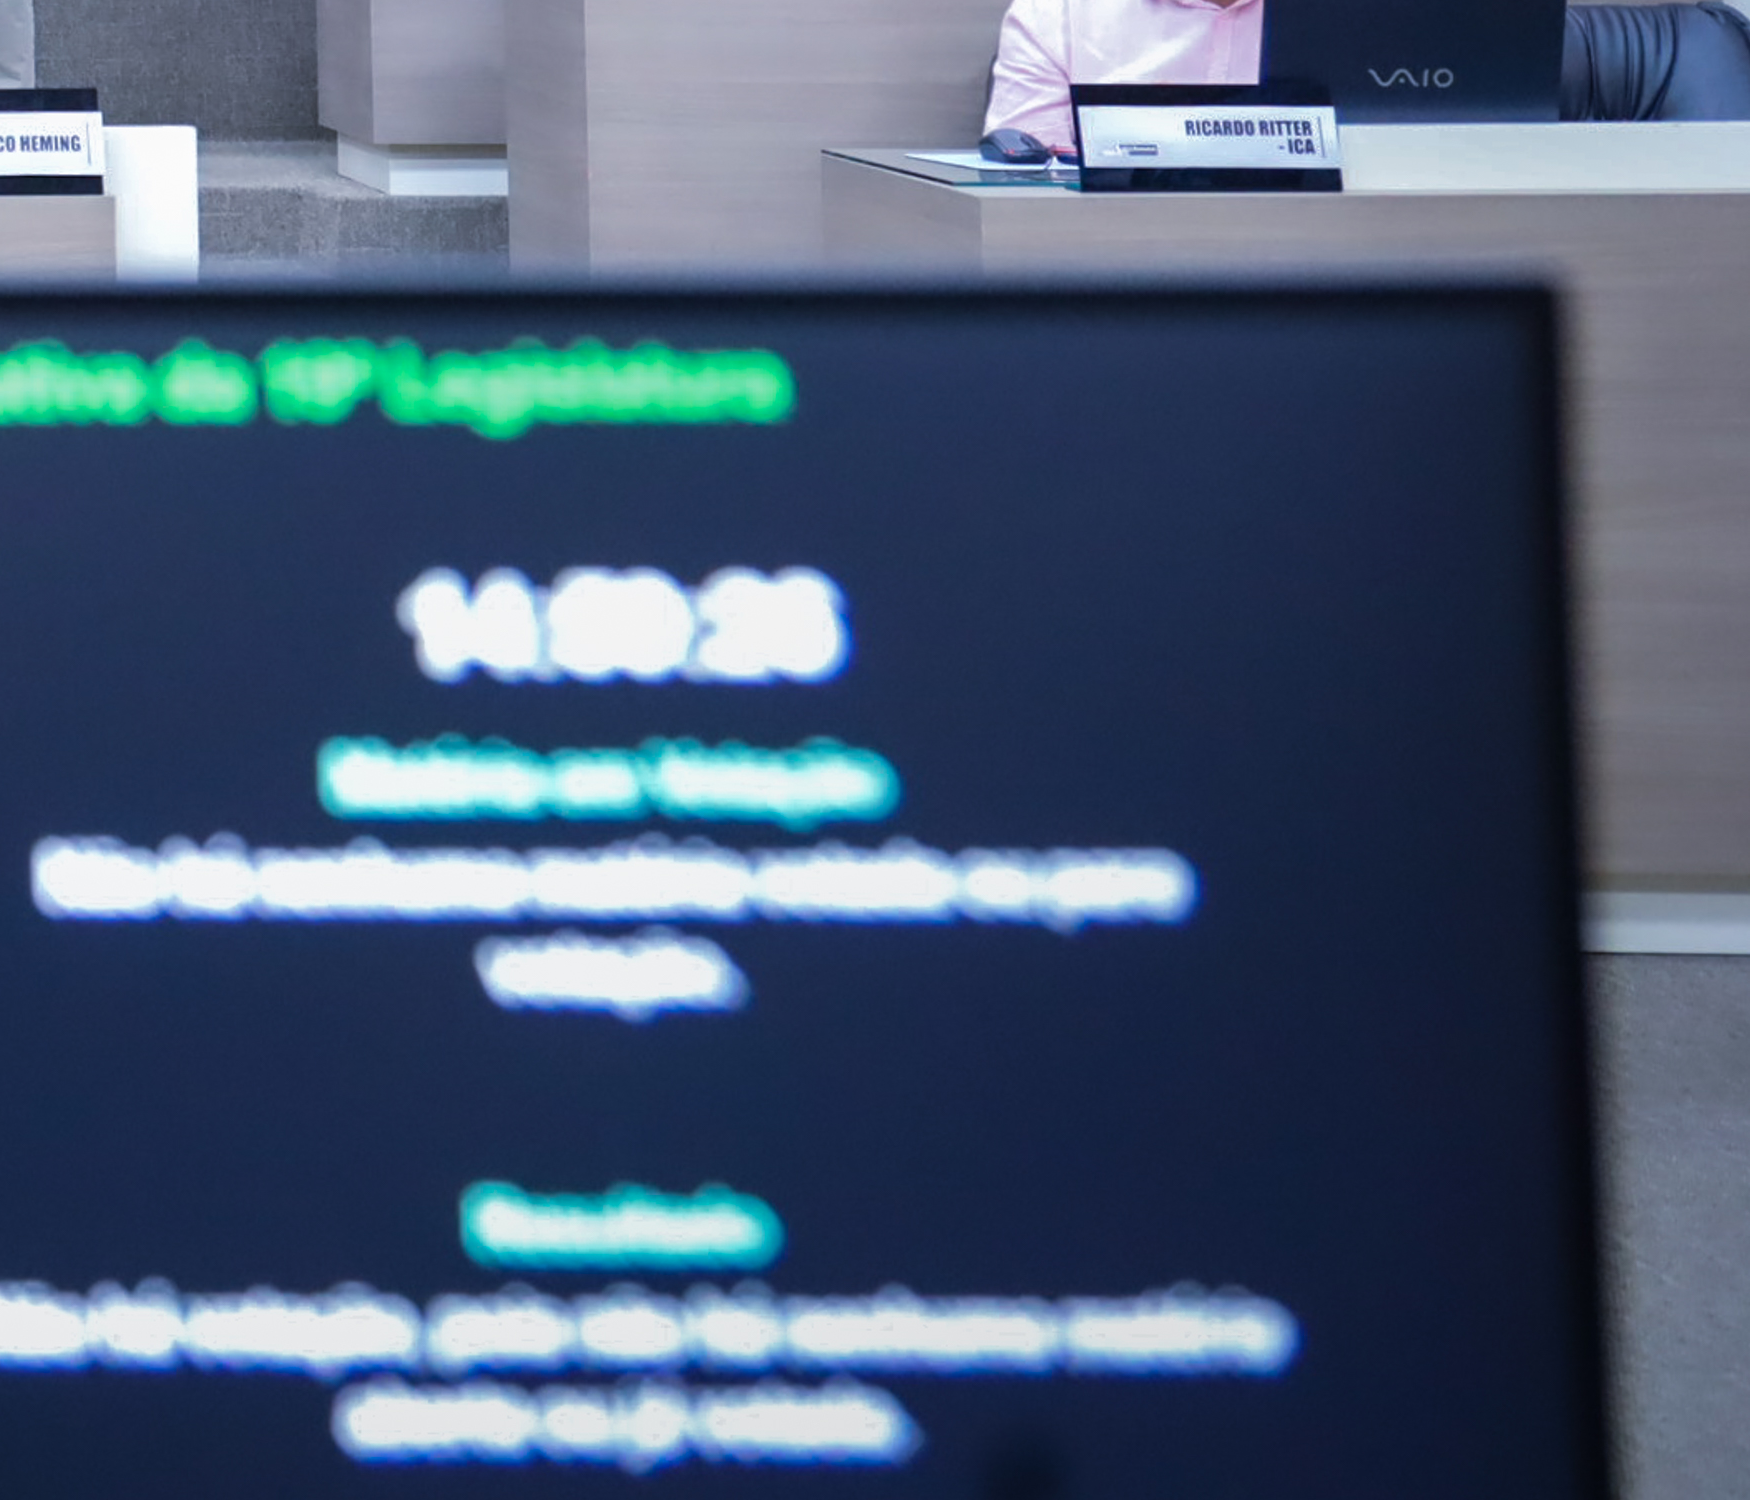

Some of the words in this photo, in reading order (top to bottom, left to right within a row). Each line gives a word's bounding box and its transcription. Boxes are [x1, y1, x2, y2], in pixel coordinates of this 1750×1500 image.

[1368, 68, 1454, 88] VAIO
[1184, 120, 1254, 137] RICARDO
[1259, 120, 1313, 137] RITTER
[19, 134, 82, 153] HEMING
[1288, 138, 1316, 155] ICA
